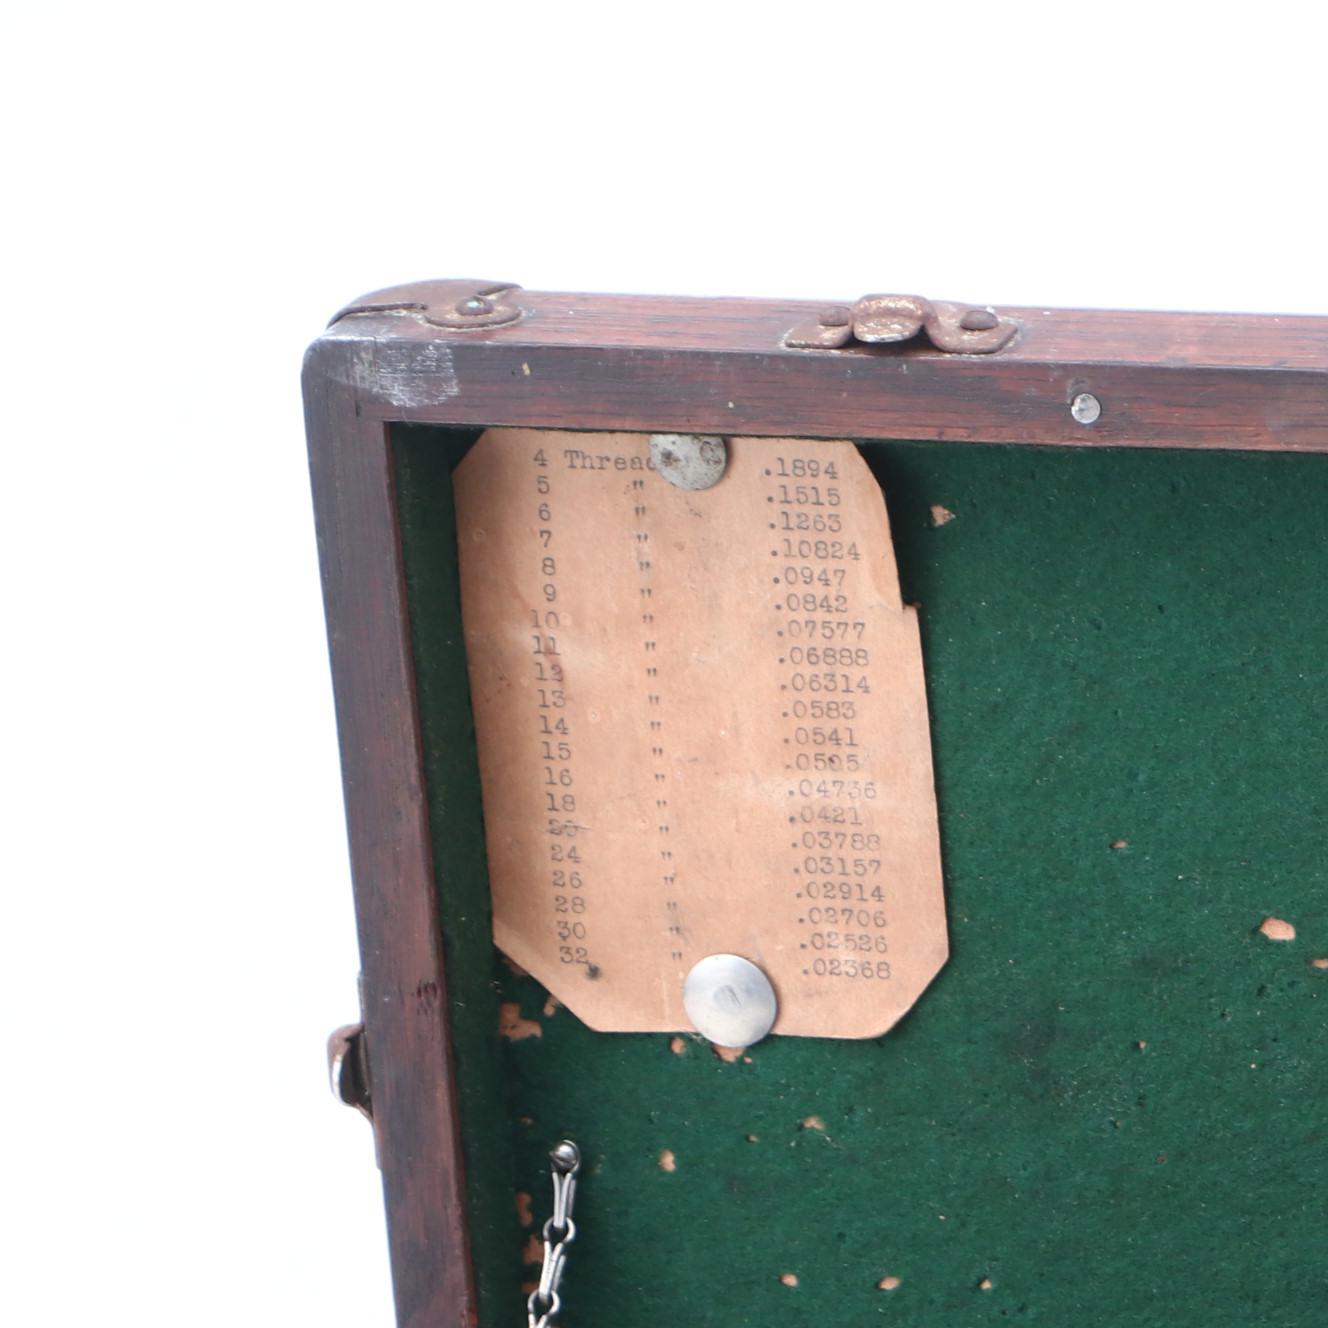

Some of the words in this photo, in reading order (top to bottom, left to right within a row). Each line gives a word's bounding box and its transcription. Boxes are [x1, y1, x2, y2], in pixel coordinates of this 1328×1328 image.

[533, 449, 548, 467] 4
[764, 457, 838, 480] .1894
[537, 476, 550, 494] 5
[766, 485, 841, 507] .1515
[538, 503, 551, 521] 6
[768, 511, 842, 533] .1263
[539, 529, 552, 548] 7
[770, 538, 860, 561] .10824
[542, 557, 556, 576] 8
[772, 566, 846, 587] .0947
[543, 584, 557, 602] 9
[774, 593, 848, 613] .0842
[531, 609, 559, 628] 10
[776, 620, 865, 640] .07577
[534, 636, 560, 657] 11
[778, 647, 869, 667] .06888
[535, 661, 565, 686] 12
[780, 673, 870, 694] .06314
[538, 685, 569, 708] 13
[782, 700, 856, 720] .0583
[540, 715, 569, 735] 14
[783, 727, 859, 747] .0541
[542, 741, 572, 760] 15
[784, 753, 859, 771] .0505
[546, 767, 573, 787] 16
[788, 779, 876, 799] .04736
[546, 793, 576, 812] 18
[788, 807, 862, 826] .0421
[791, 831, 880, 850] .03788
[551, 845, 581, 864] 24
[793, 856, 881, 877] .03157
[553, 871, 583, 889] 26
[796, 882, 885, 902] .02914
[555, 896, 586, 914] 28
[798, 907, 887, 928] .02706
[558, 921, 586, 941] 30
[800, 932, 888, 954] .02526
[559, 946, 588, 965] 32
[802, 958, 891, 980] .02368
